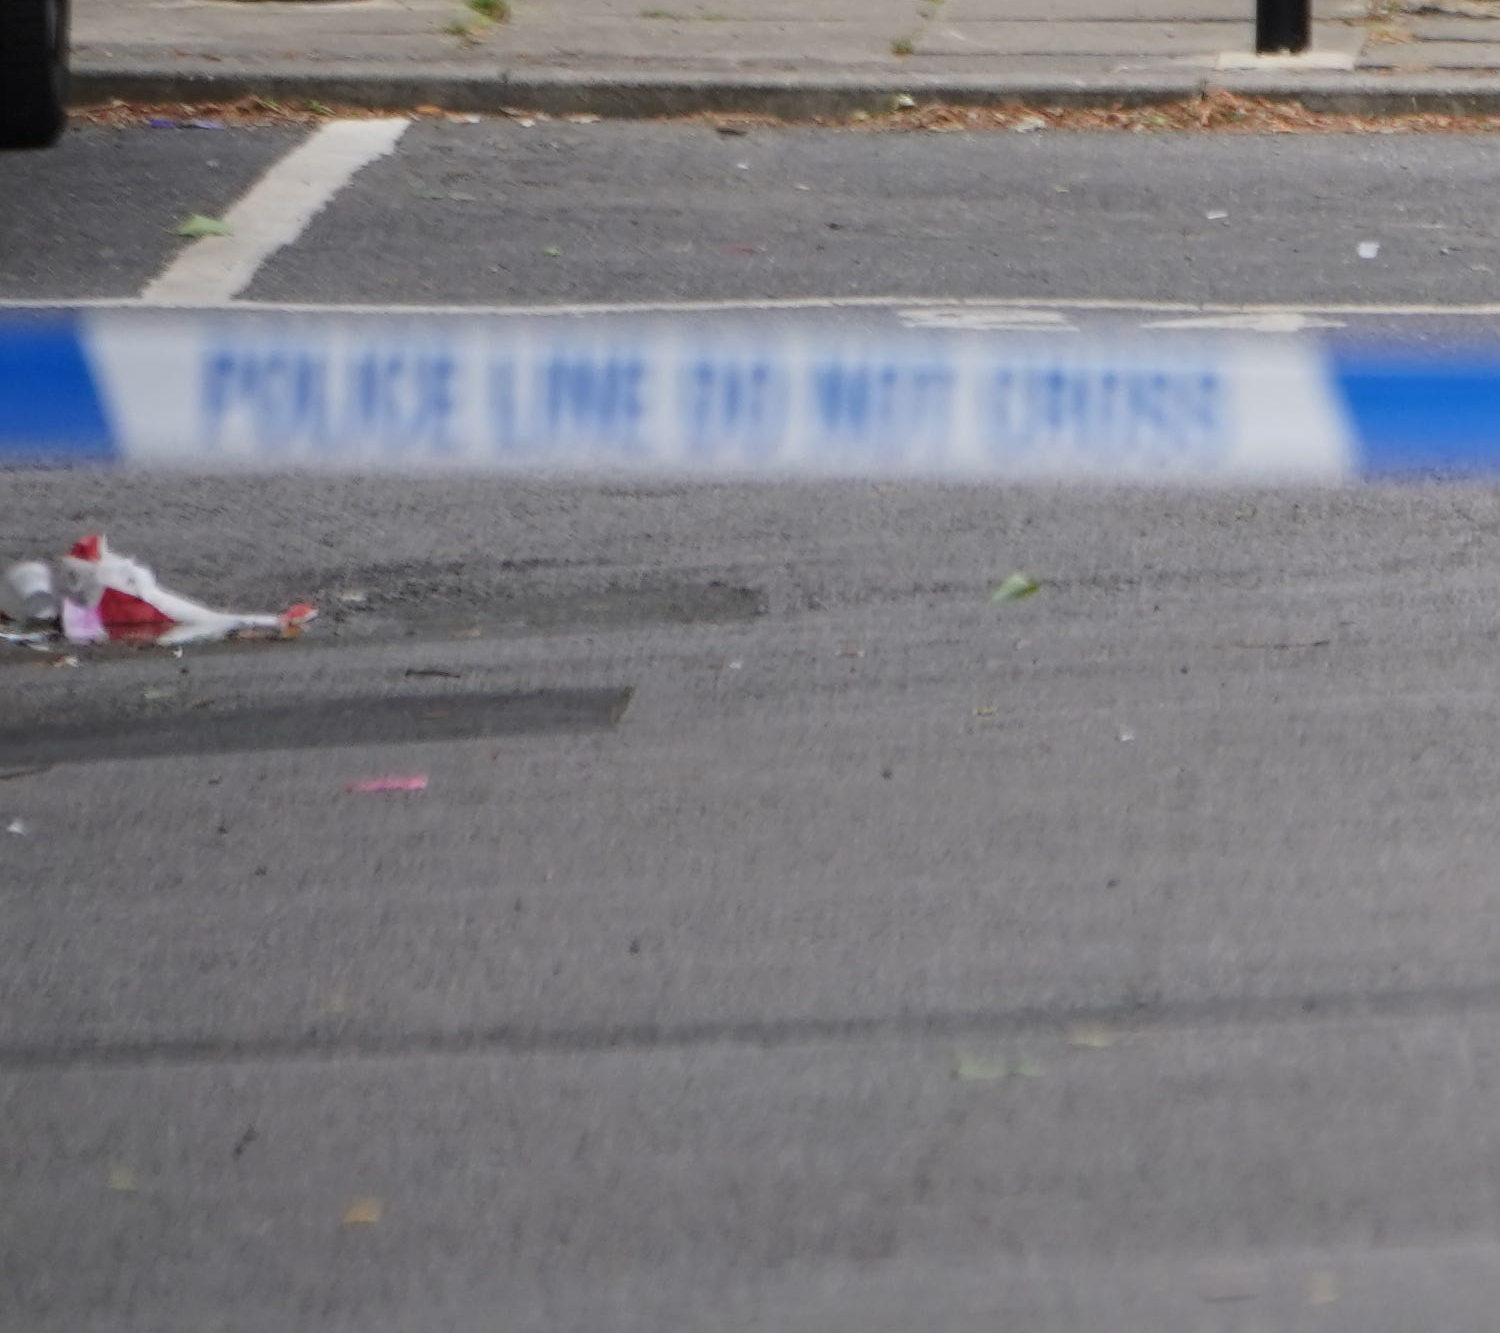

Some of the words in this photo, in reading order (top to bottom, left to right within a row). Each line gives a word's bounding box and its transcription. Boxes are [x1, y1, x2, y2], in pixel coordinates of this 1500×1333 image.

[199, 348, 457, 451] POLICE
[492, 351, 650, 455] LINE
[680, 355, 785, 455] DO
